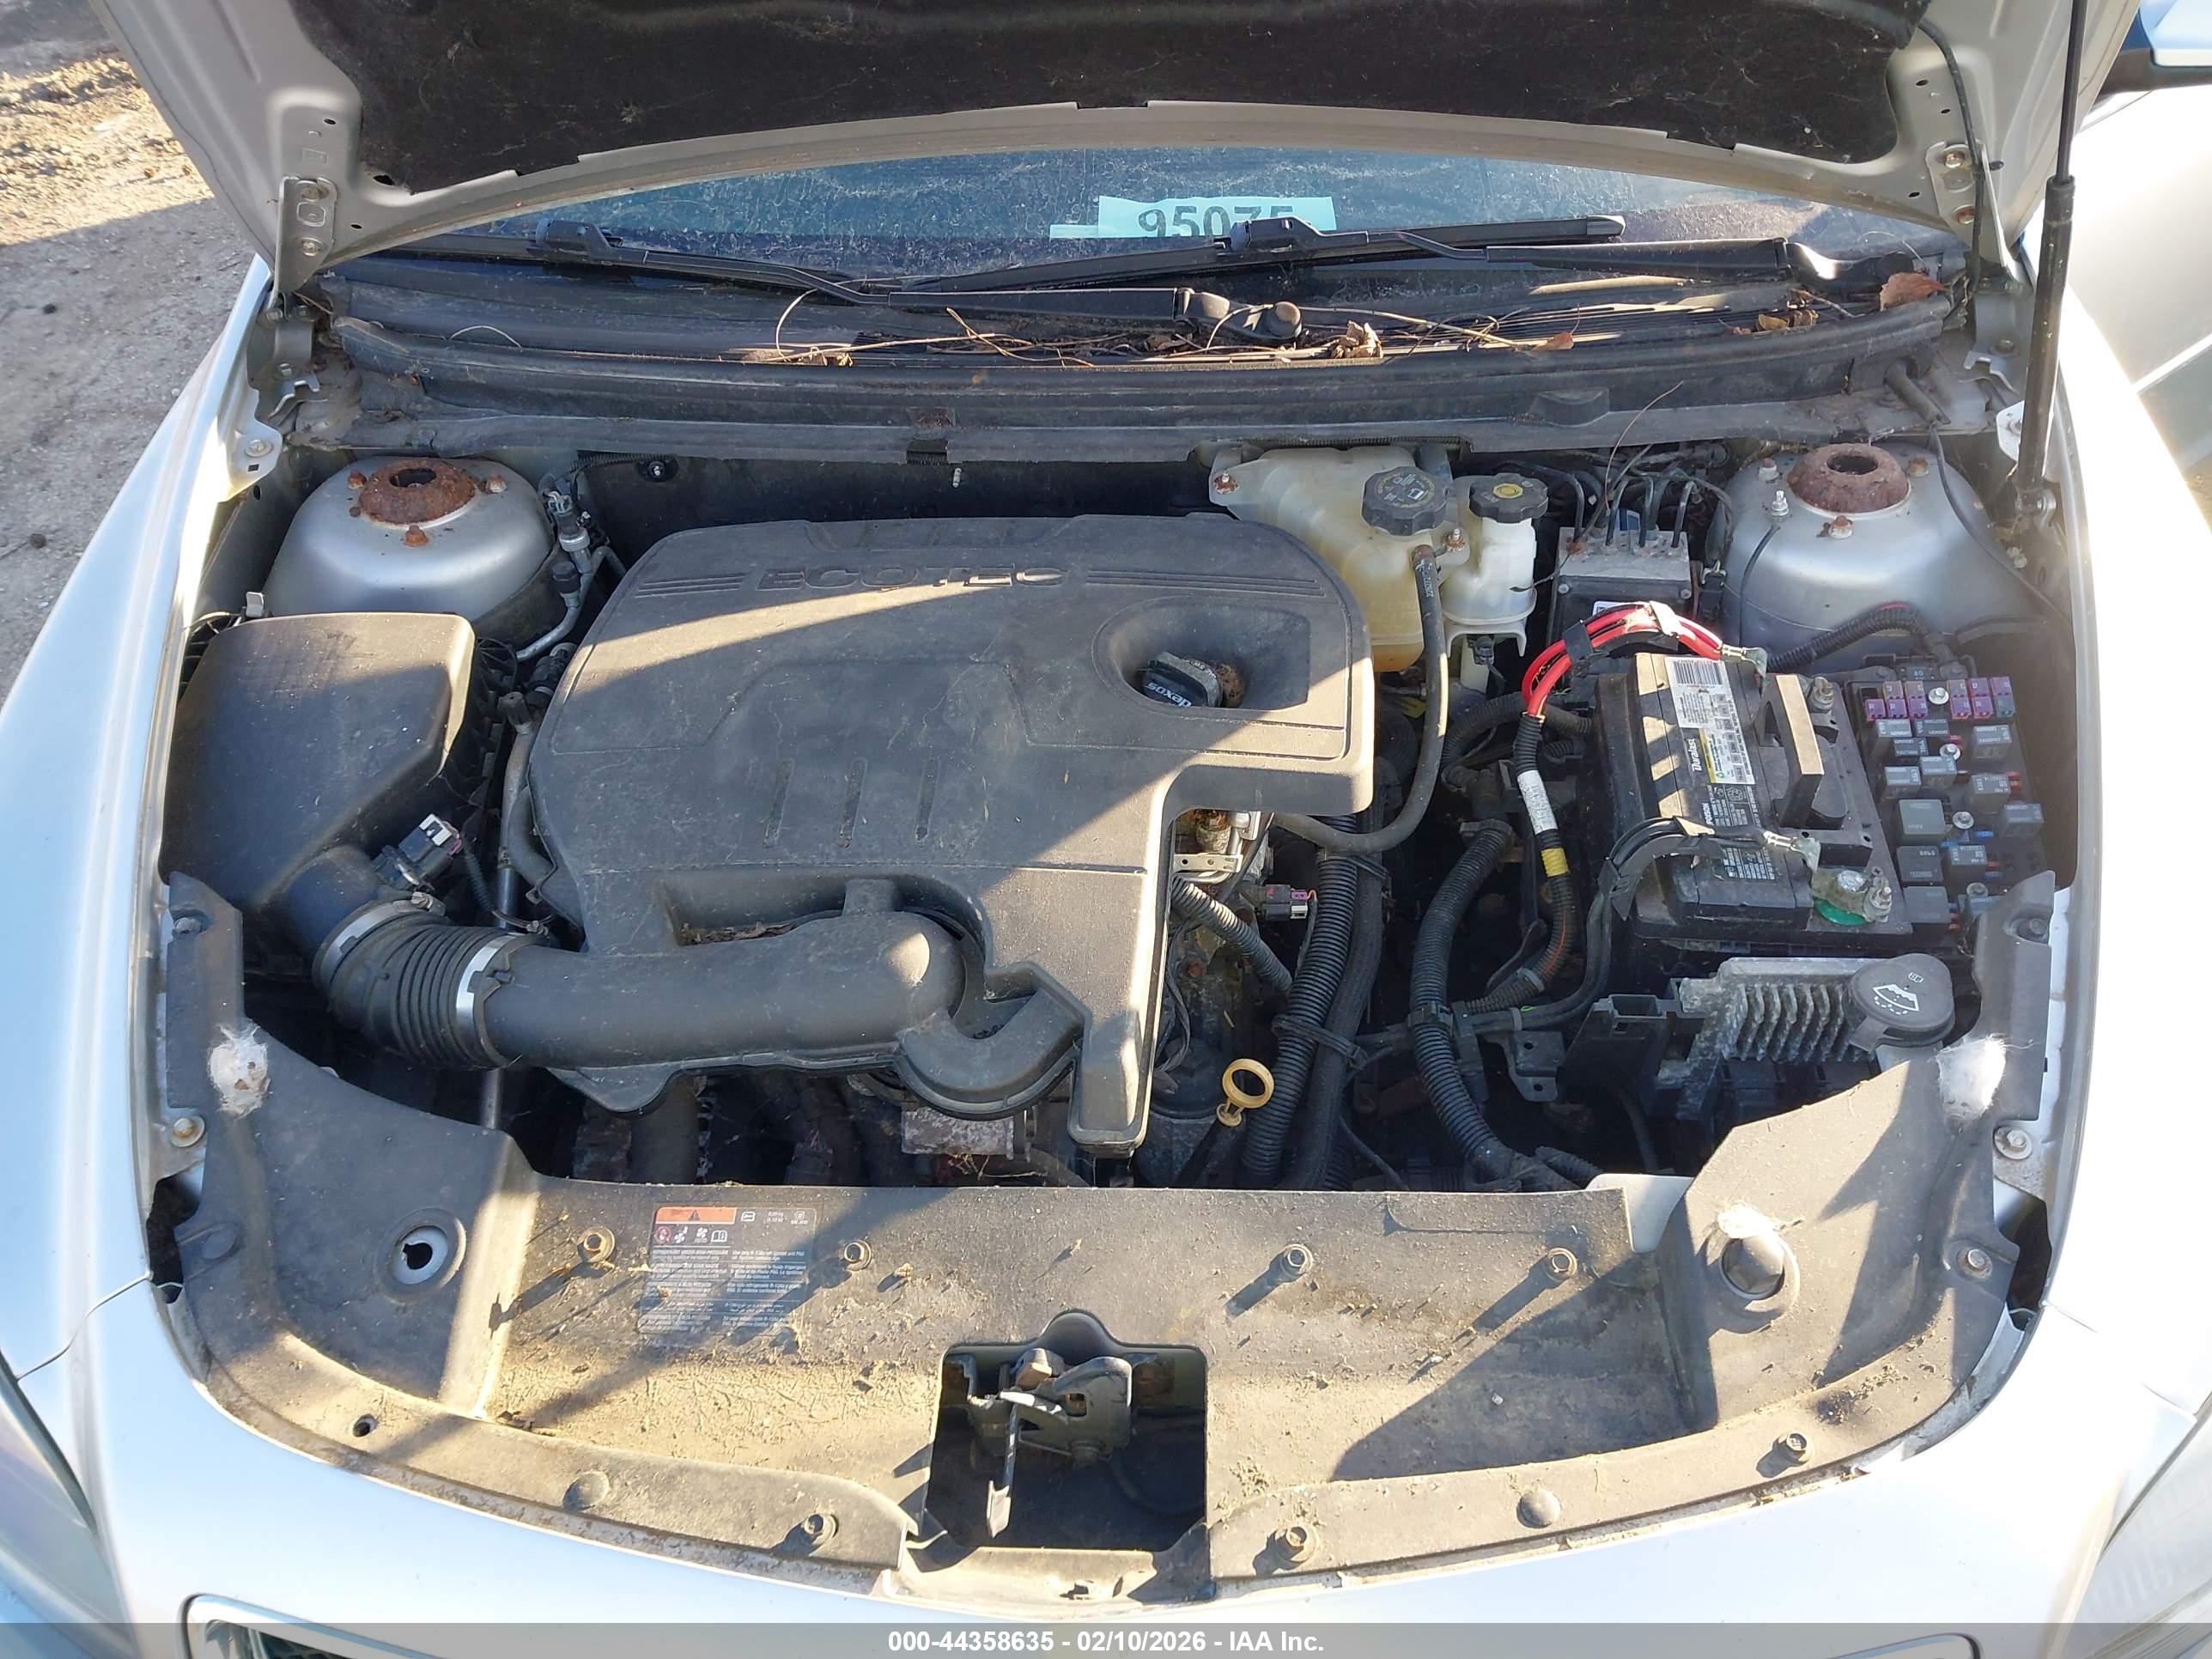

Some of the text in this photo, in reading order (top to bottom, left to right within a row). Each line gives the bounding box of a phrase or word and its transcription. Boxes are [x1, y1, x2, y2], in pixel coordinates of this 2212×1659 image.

[757, 564, 1070, 590] ECOTEC
[1146, 682, 1192, 708] dexos
[1688, 738, 1703, 772] Duralast
[1703, 802, 1712, 825] POISON
